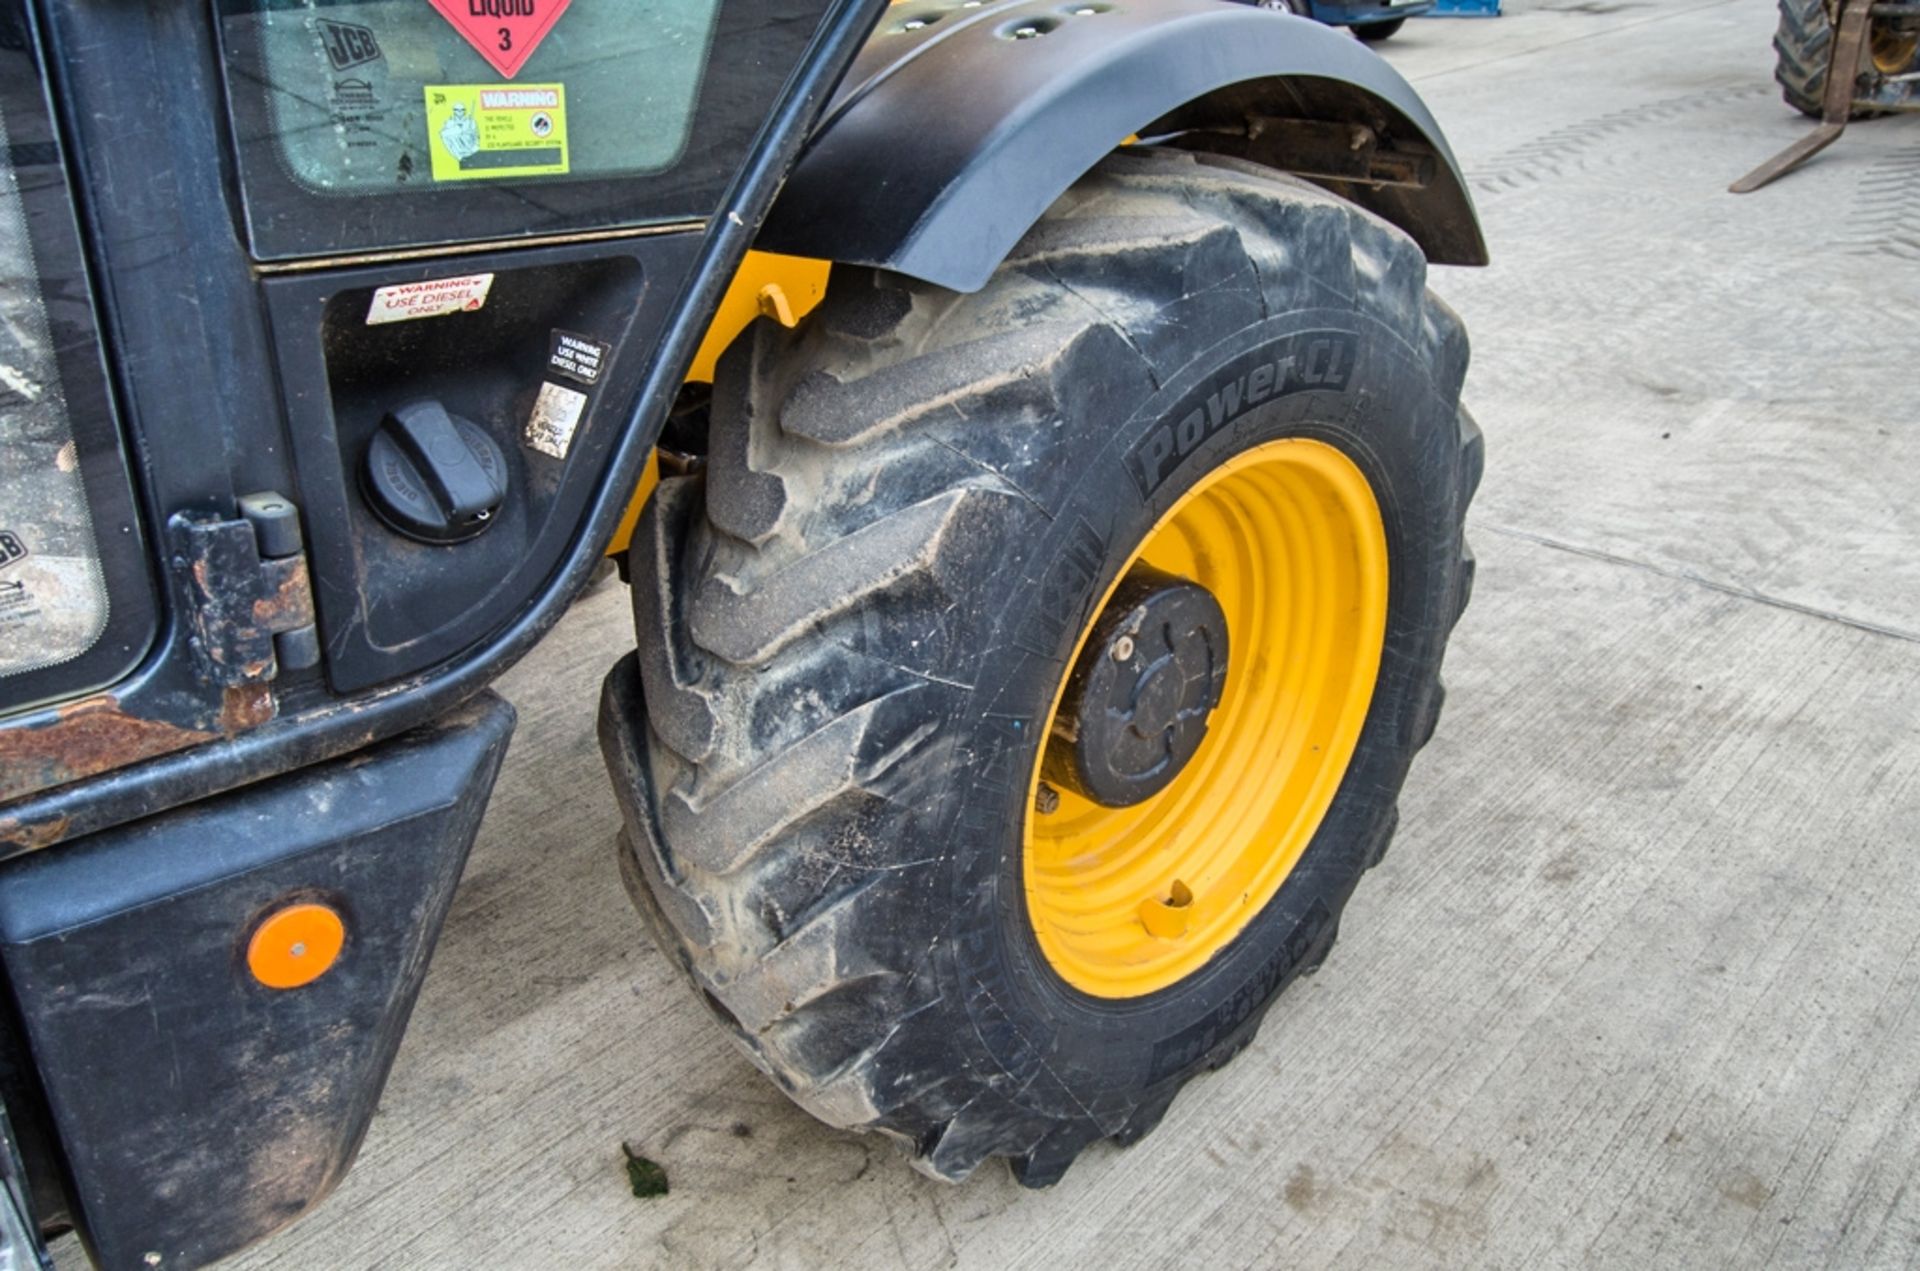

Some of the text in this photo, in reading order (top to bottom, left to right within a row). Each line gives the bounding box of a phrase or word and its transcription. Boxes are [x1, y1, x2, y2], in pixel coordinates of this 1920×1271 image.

[468, 0, 535, 18] LIQUID
[325, 23, 377, 66] JCB
[498, 28, 512, 51] 3
[482, 91, 556, 108] WARNING
[399, 279, 471, 295] WARNING
[385, 289, 472, 309] USE DIESEL
[407, 304, 445, 316] ONLY
[558, 345, 600, 368] USE WHITE
[560, 335, 601, 358] WARNING
[551, 354, 598, 379] DIESEL ONLY
[1137, 338, 1346, 484] Power CL
[385, 460, 418, 501] DIESEL
